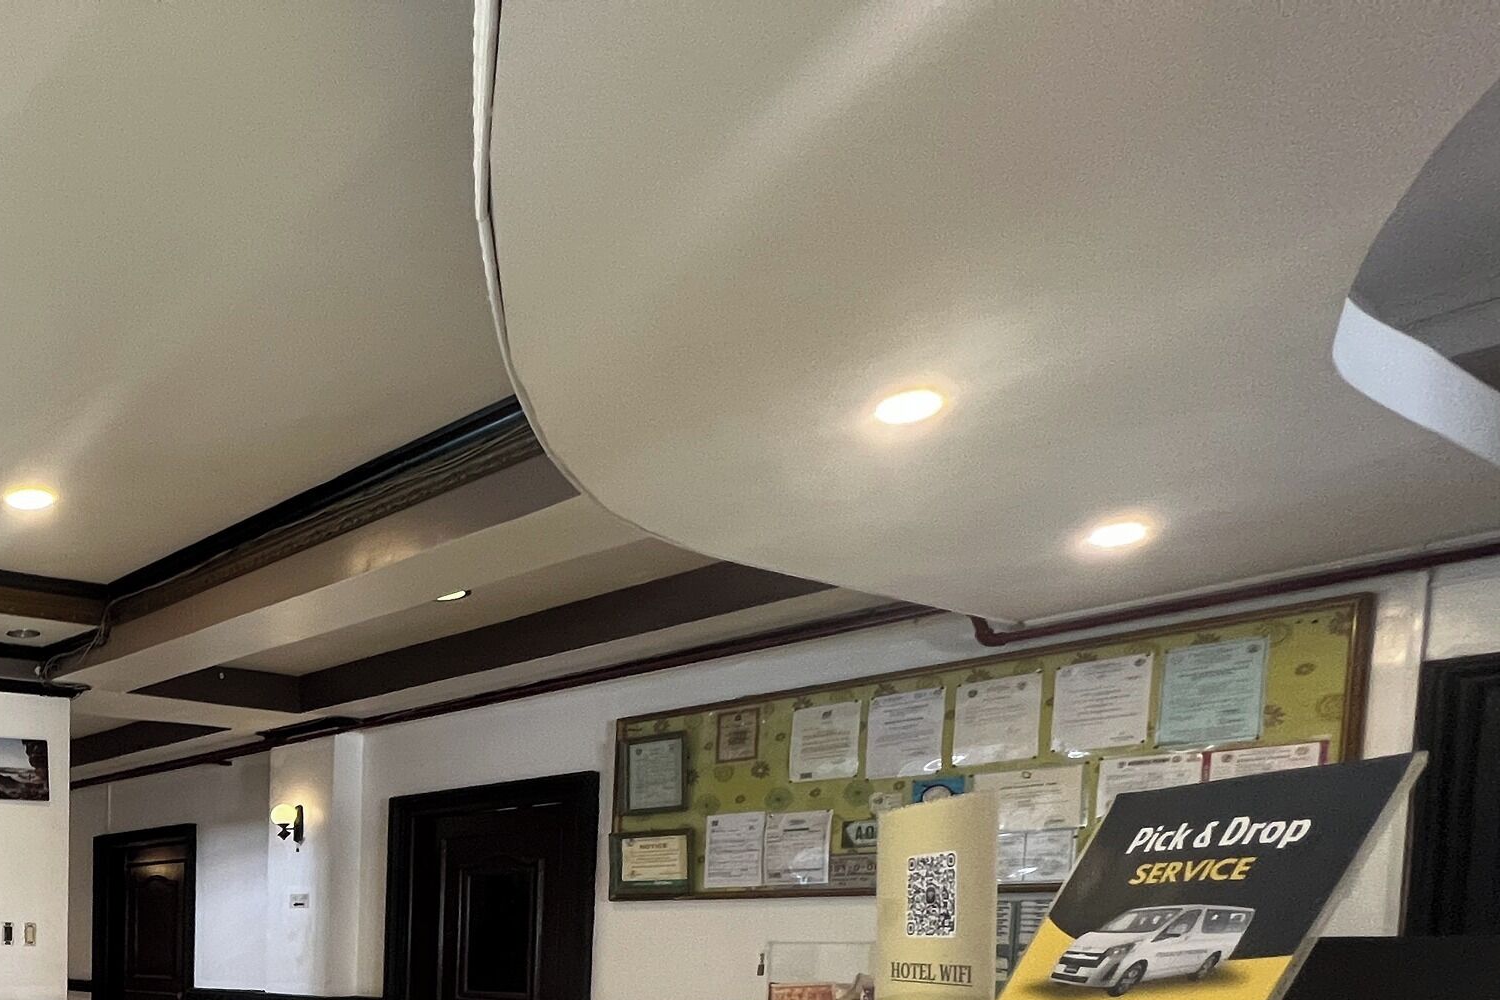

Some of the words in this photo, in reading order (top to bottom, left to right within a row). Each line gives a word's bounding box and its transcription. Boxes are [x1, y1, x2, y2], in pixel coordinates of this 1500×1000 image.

[1125, 822, 1193, 854] Pick
[1193, 821, 1220, 848] &
[1218, 816, 1312, 849] Drop
[1128, 857, 1257, 885] SERVICE
[891, 962, 935, 981] HOTEL
[940, 964, 972, 984] WIFI
